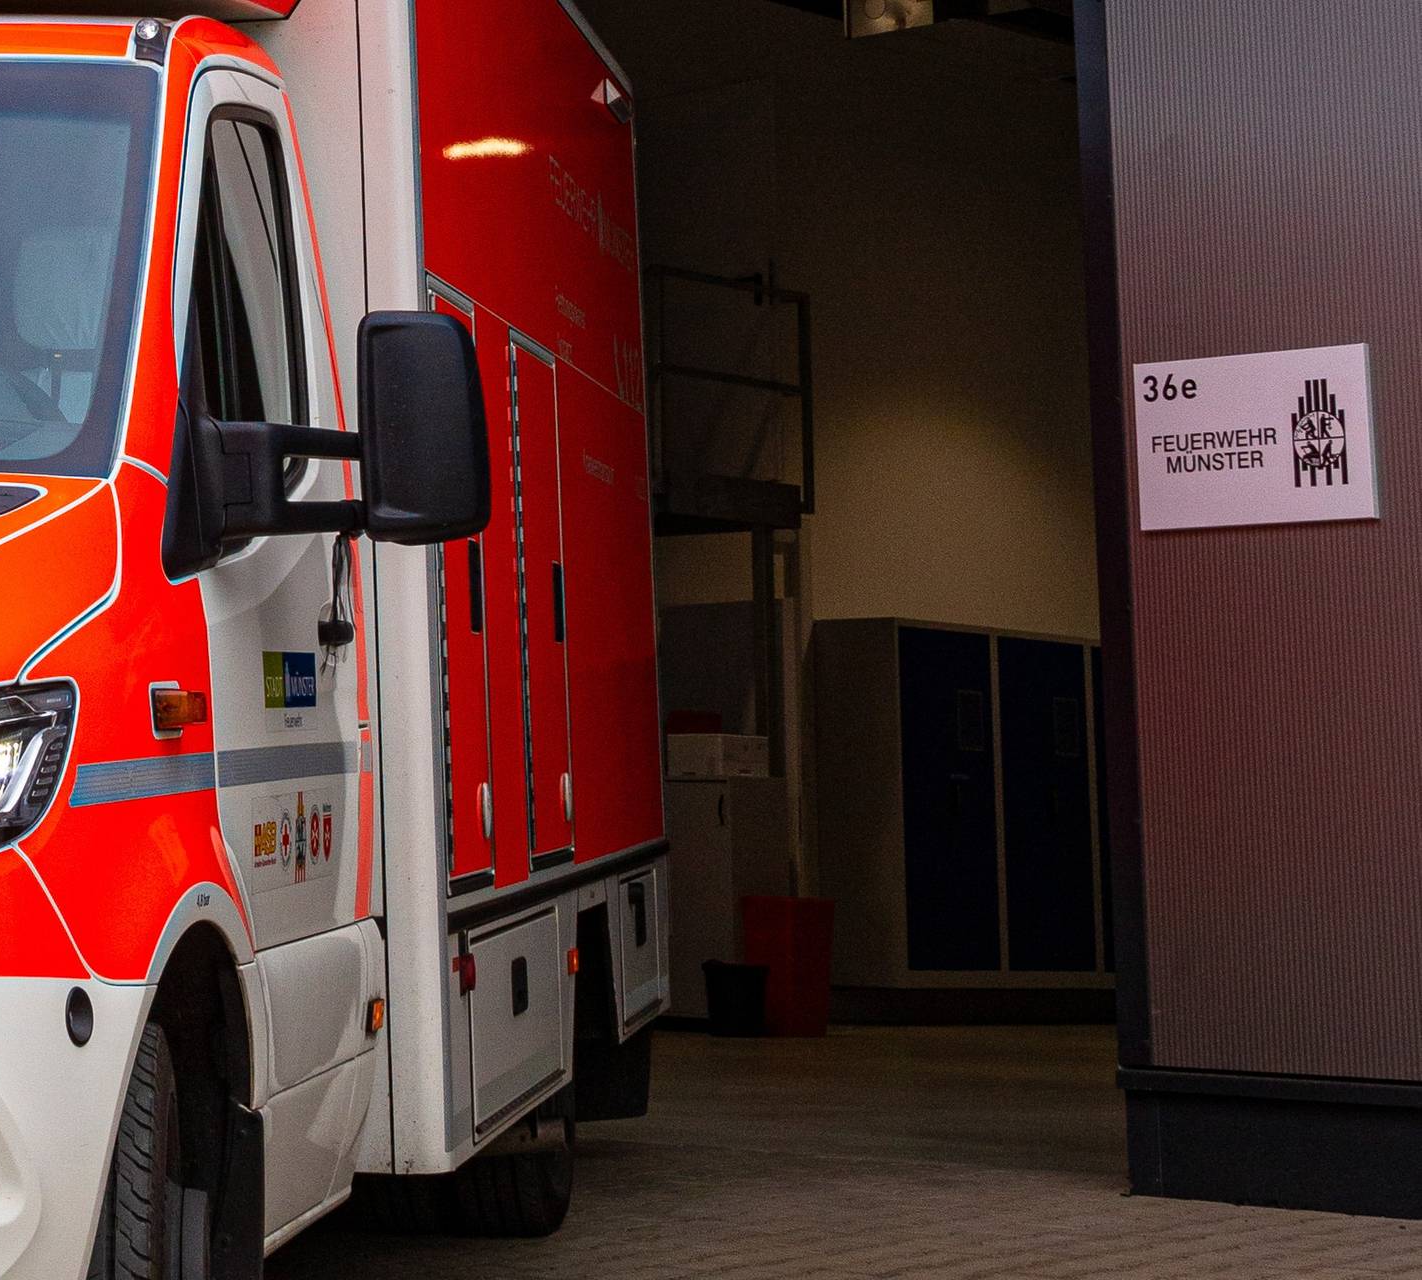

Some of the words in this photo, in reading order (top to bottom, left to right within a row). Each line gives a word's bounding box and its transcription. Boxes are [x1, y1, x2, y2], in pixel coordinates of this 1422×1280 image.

[1143, 373, 1198, 403] 36e
[1151, 427, 1278, 454] FEUERWEHR
[1166, 450, 1264, 474] MÜNSTER
[265, 676, 283, 698] STADT
